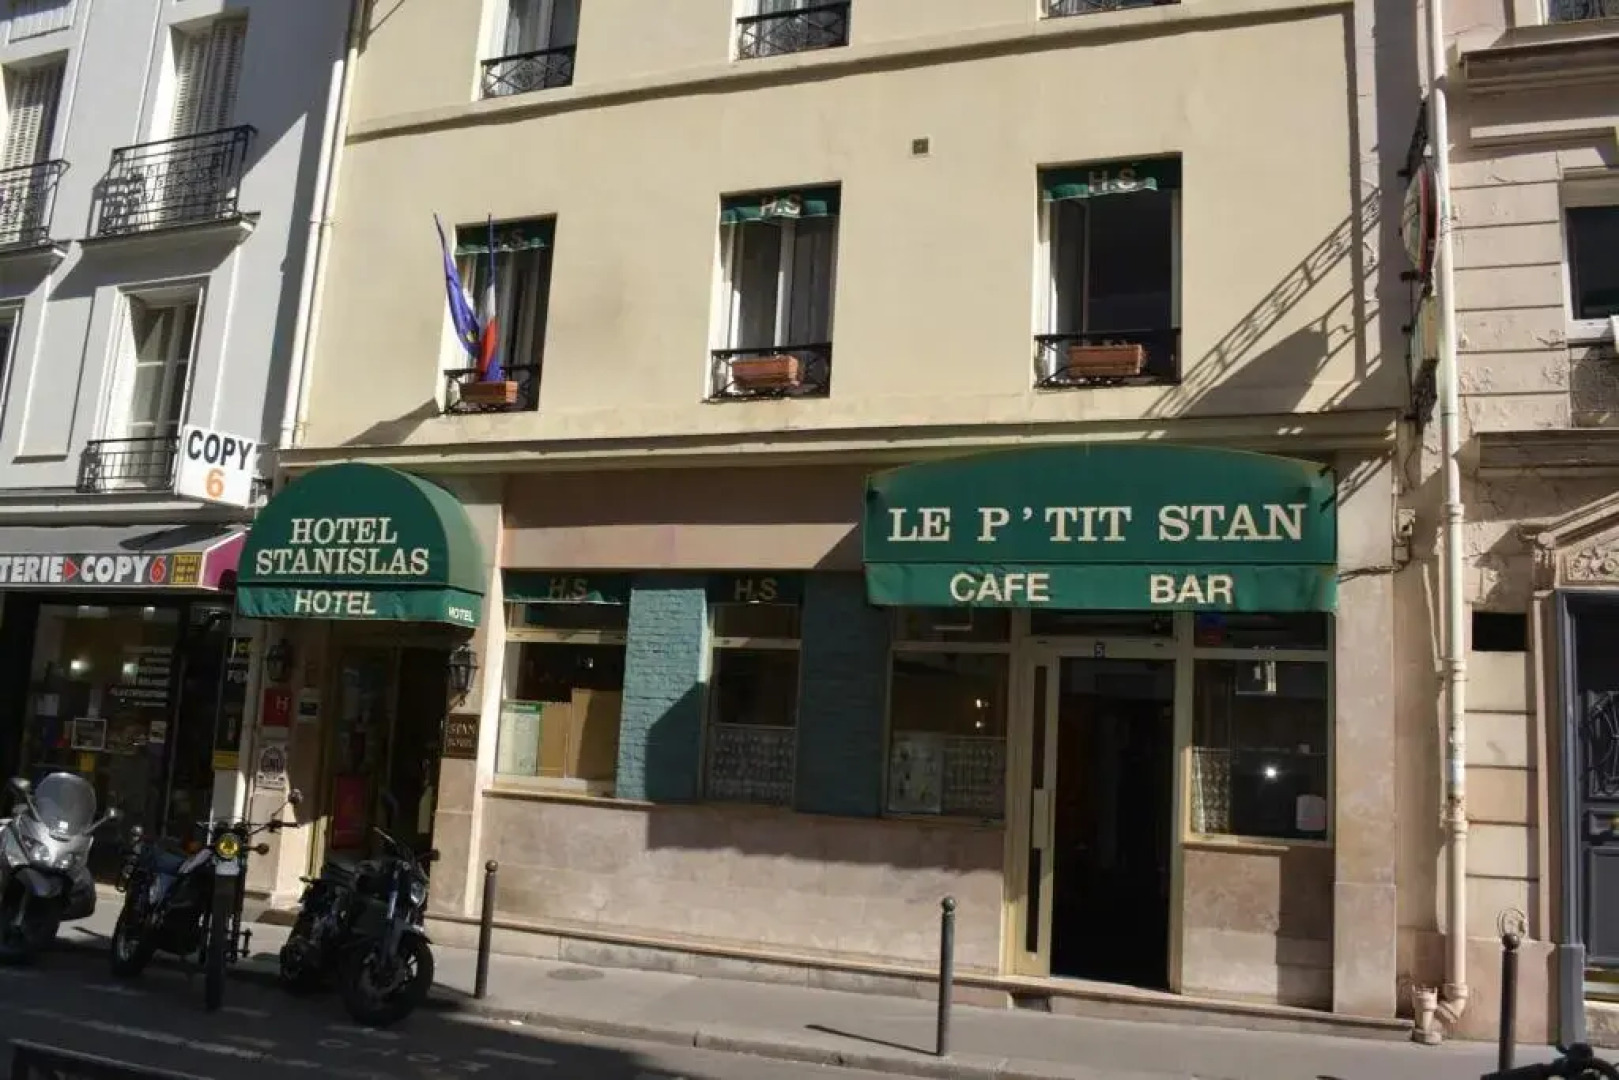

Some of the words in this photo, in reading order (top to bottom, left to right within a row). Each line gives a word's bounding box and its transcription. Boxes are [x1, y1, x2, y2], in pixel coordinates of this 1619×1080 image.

[187, 430, 253, 470] COPY
[205, 467, 225, 498] 6
[289, 517, 398, 545] HOTEL
[887, 507, 951, 542] LE
[1158, 504, 1307, 542] STAN
[256, 548, 429, 575] STANISLAS
[949, 572, 1051, 603] CAFE
[1149, 573, 1235, 606] BAR
[293, 590, 377, 615] HOTEL
[448, 606, 475, 623] HOTEL
